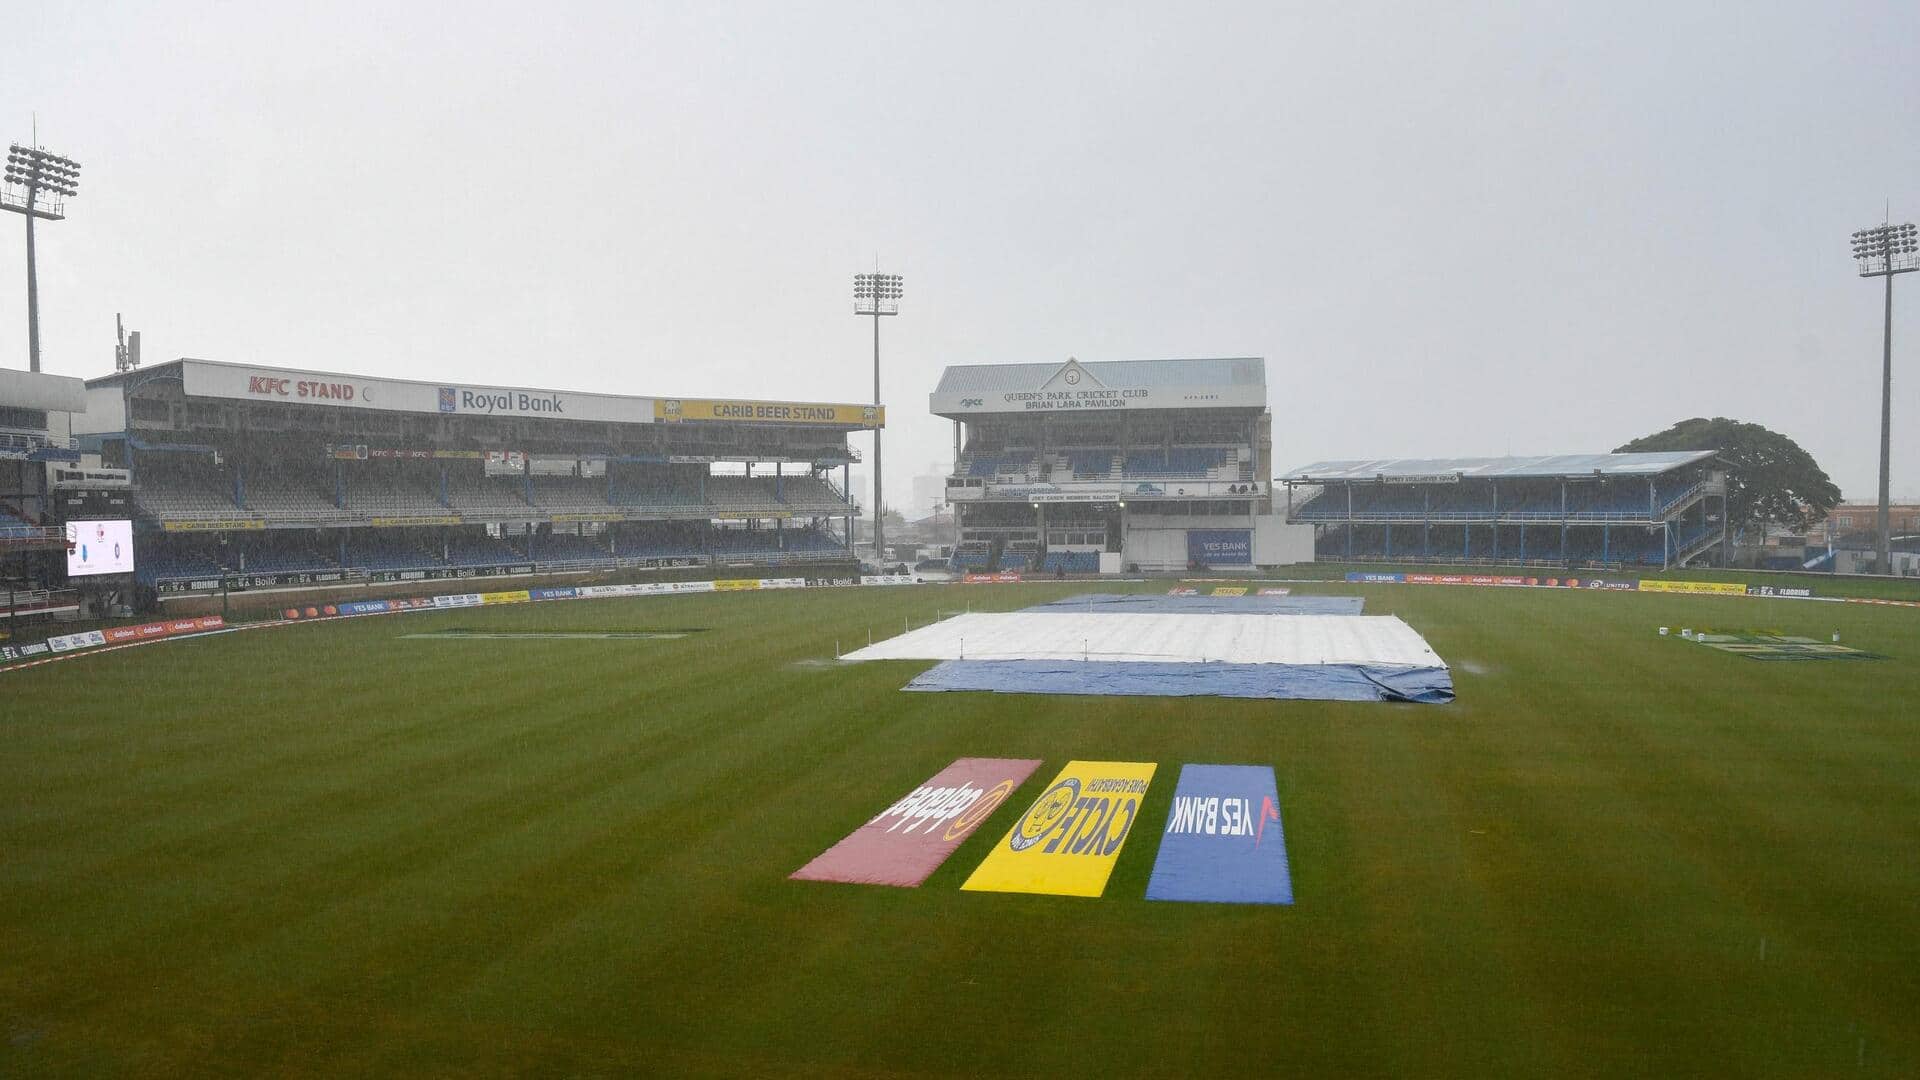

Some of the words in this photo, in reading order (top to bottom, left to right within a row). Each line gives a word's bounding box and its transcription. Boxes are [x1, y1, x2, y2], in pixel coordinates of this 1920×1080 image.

[249, 376, 290, 395] KFC
[297, 381, 354, 400] STAND
[1004, 392, 1043, 402] QUEEN'S
[1047, 391, 1071, 401] PARK
[1076, 390, 1118, 400] CRICKET
[1122, 389, 1149, 399] CLUB
[462, 391, 513, 413] Royal
[519, 394, 563, 412] Bank
[1026, 400, 1053, 409] BRIAN
[1057, 400, 1082, 409] LARA
[1085, 399, 1126, 408] PAVILION
[713, 405, 753, 418] CARIB
[757, 406, 792, 419] BEER
[793, 407, 835, 420] STAND
[1203, 542, 1220, 550] YES
[1222, 542, 1247, 551] BANK
[556, 589, 573, 597] BANK
[1780, 588, 1810, 597] FLOORING
[353, 604, 366, 612] YES
[367, 602, 384, 611] BANK
[143, 625, 164, 635] dafabet
[1128, 778, 1149, 794] PURE
[870, 781, 984, 834] dafabet
[1167, 796, 1217, 834] BANK
[1221, 798, 1254, 836] YES
[1042, 797, 1136, 856] CYCLE
